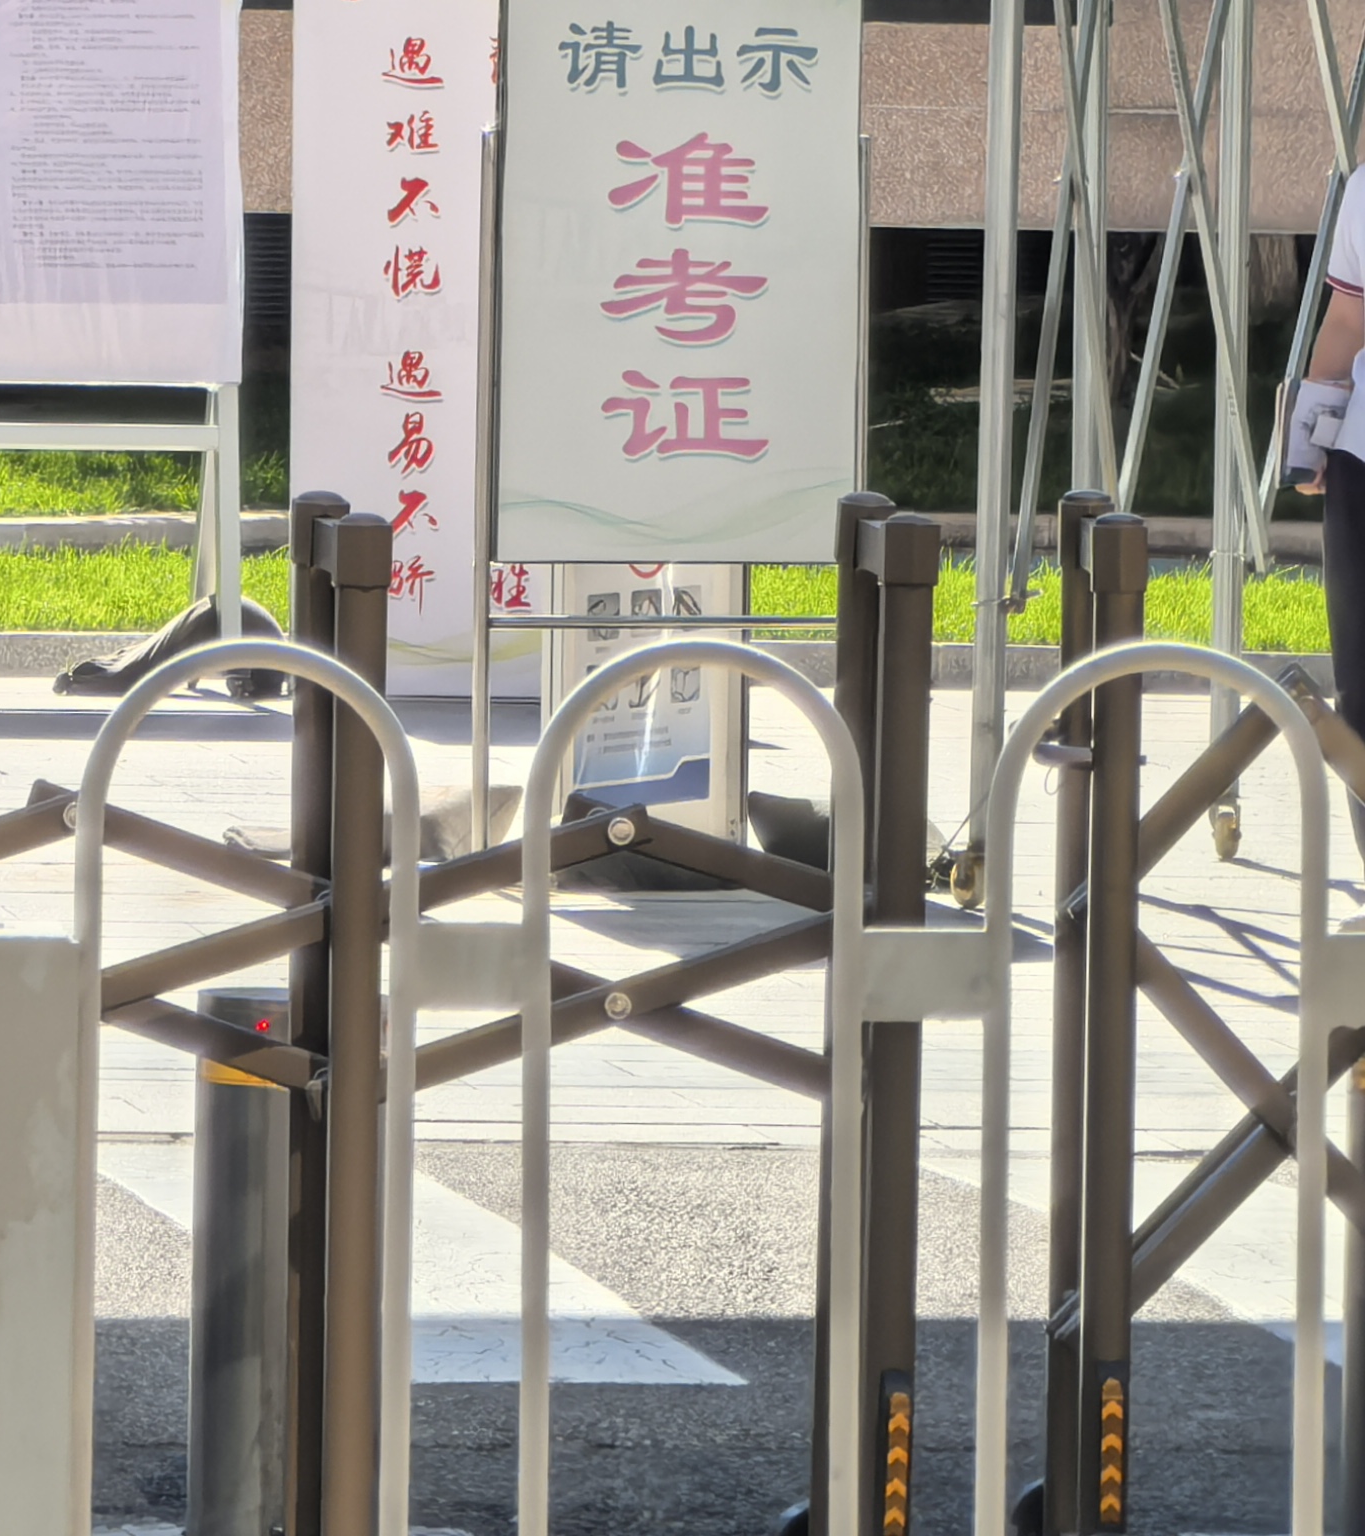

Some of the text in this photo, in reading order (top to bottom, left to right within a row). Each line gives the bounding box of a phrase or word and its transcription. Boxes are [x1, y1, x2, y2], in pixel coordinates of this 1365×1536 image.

[382, 36, 443, 297] 遇难不慌
[559, 20, 819, 94] 请出示
[600, 132, 769, 459] 准考证
[380, 350, 442, 614] 遇易不骄
